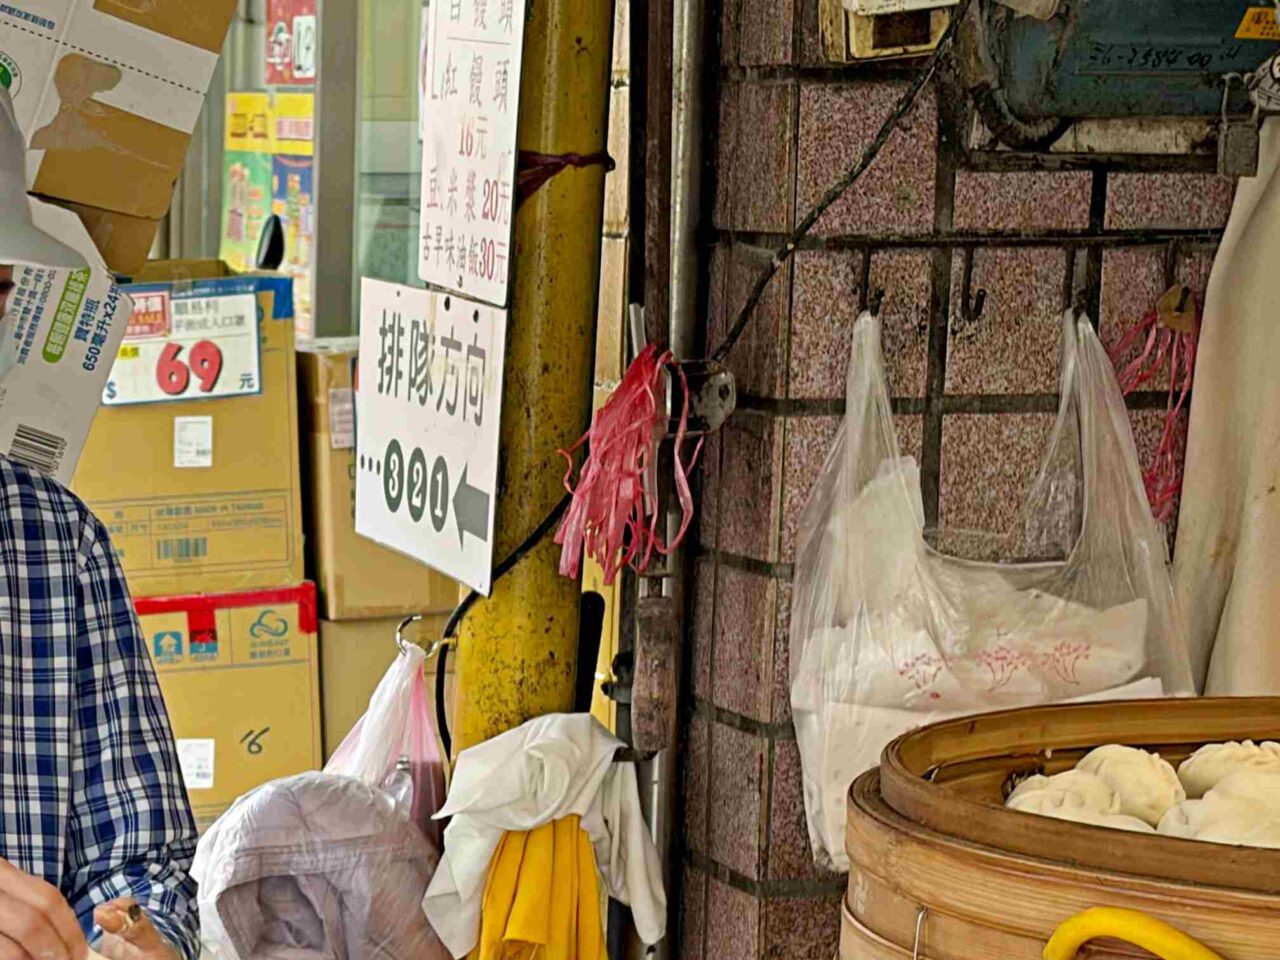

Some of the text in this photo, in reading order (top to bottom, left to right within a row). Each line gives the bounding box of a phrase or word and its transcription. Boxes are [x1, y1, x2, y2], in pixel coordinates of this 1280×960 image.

[440, 51, 509, 114] 紅饅頭
[156, 338, 223, 396] 69
[239, 373, 254, 390] 元
[378, 308, 487, 428] 排隊方向
